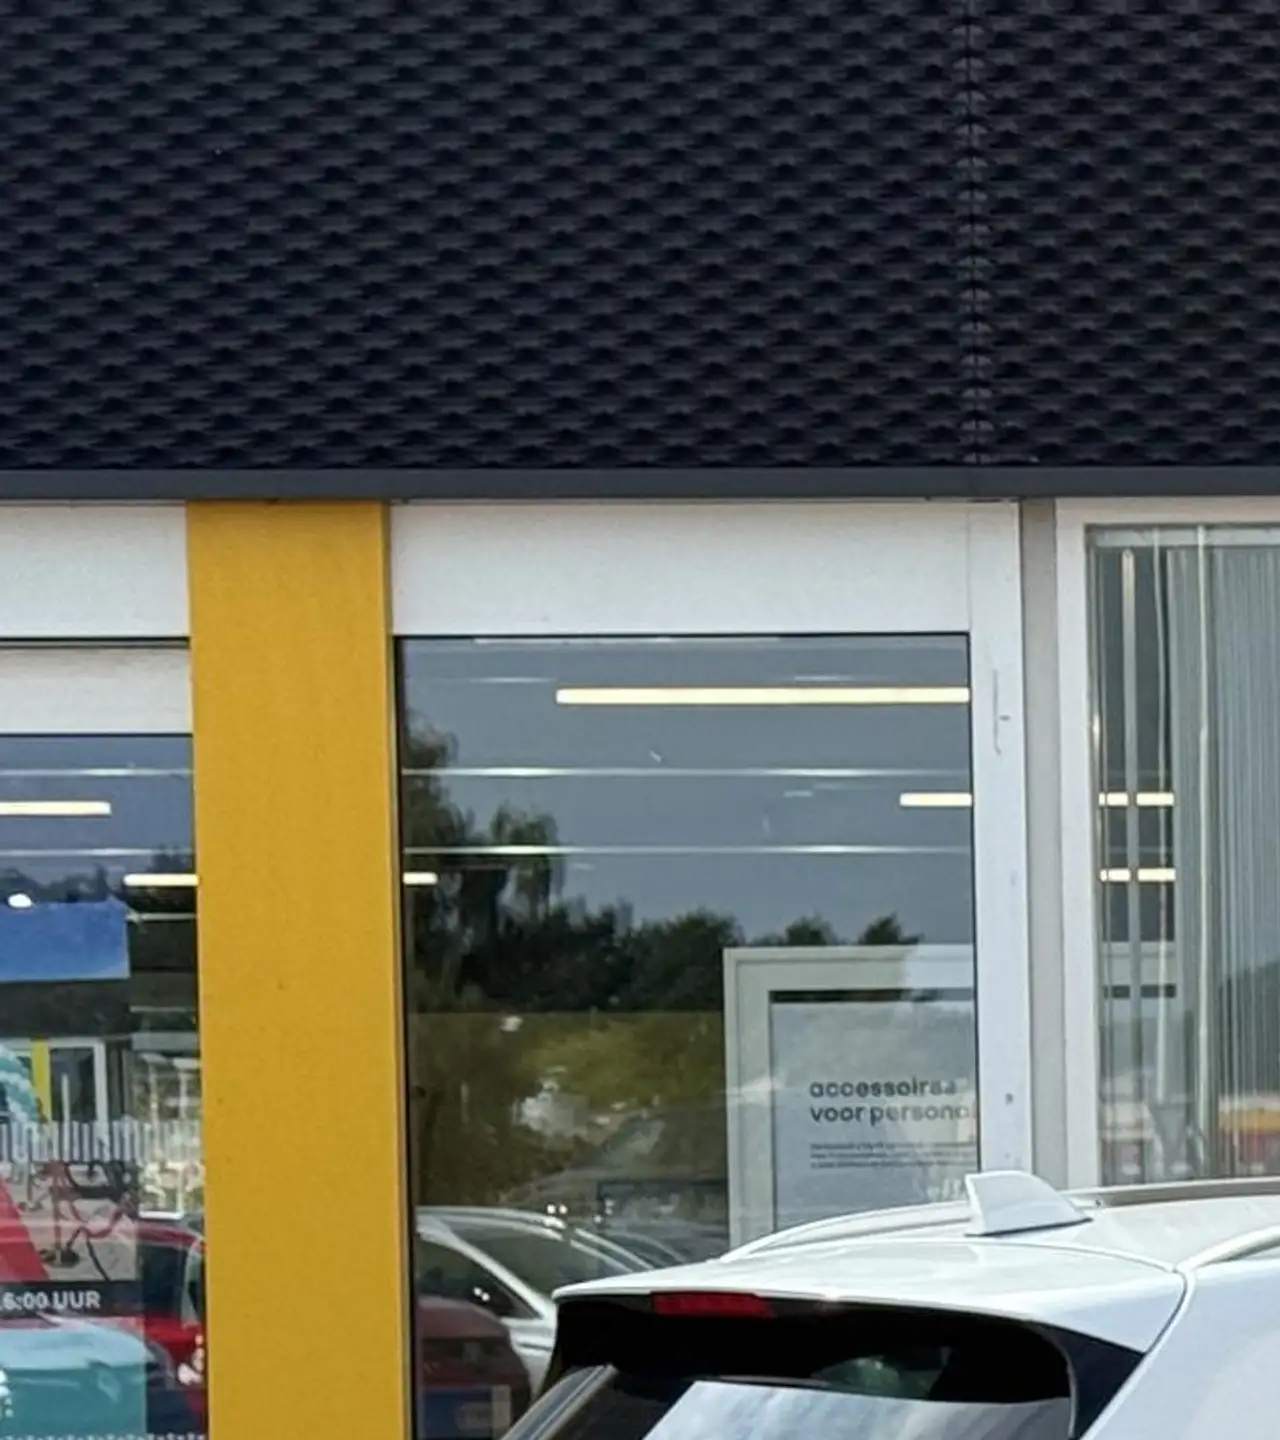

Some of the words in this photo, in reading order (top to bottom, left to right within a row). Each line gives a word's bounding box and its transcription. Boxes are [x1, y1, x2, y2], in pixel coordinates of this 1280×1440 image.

[810, 1106, 864, 1122] voor
[870, 1104, 978, 1126] persona
[52, 1290, 101, 1310] UUR
